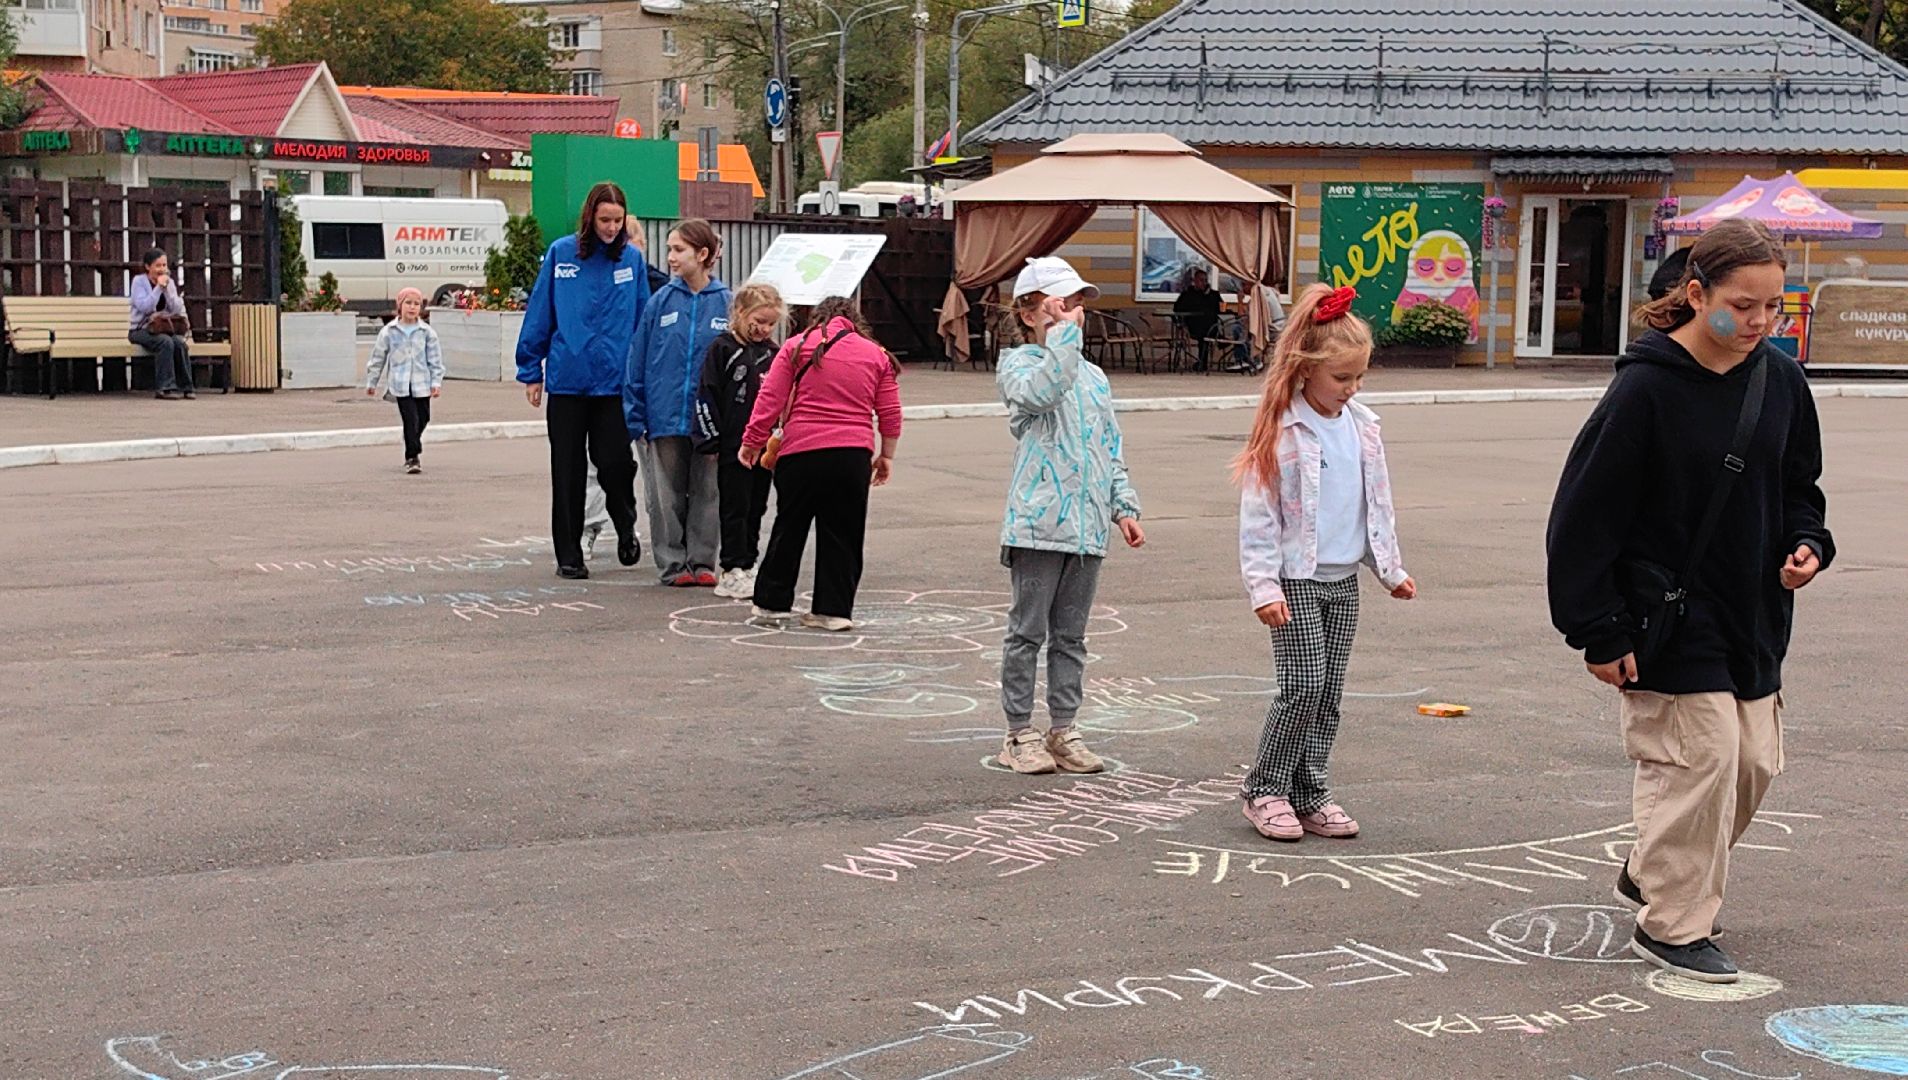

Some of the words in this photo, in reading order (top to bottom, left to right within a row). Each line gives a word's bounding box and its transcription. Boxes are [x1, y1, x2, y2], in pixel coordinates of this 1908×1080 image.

[620, 122, 638, 134] 24
[22, 131, 71, 151] АПТЕКА
[166, 135, 245, 155] АПТЕКА
[273, 142, 347, 160] МЕЛОДИЯ
[357, 147, 430, 164] ЗДОРОВЬЯ
[394, 226, 489, 242] ARMTEK
[1840, 311, 1906, 324] сладкая
[1394, 993, 1652, 1038] ВЕНЕРА
